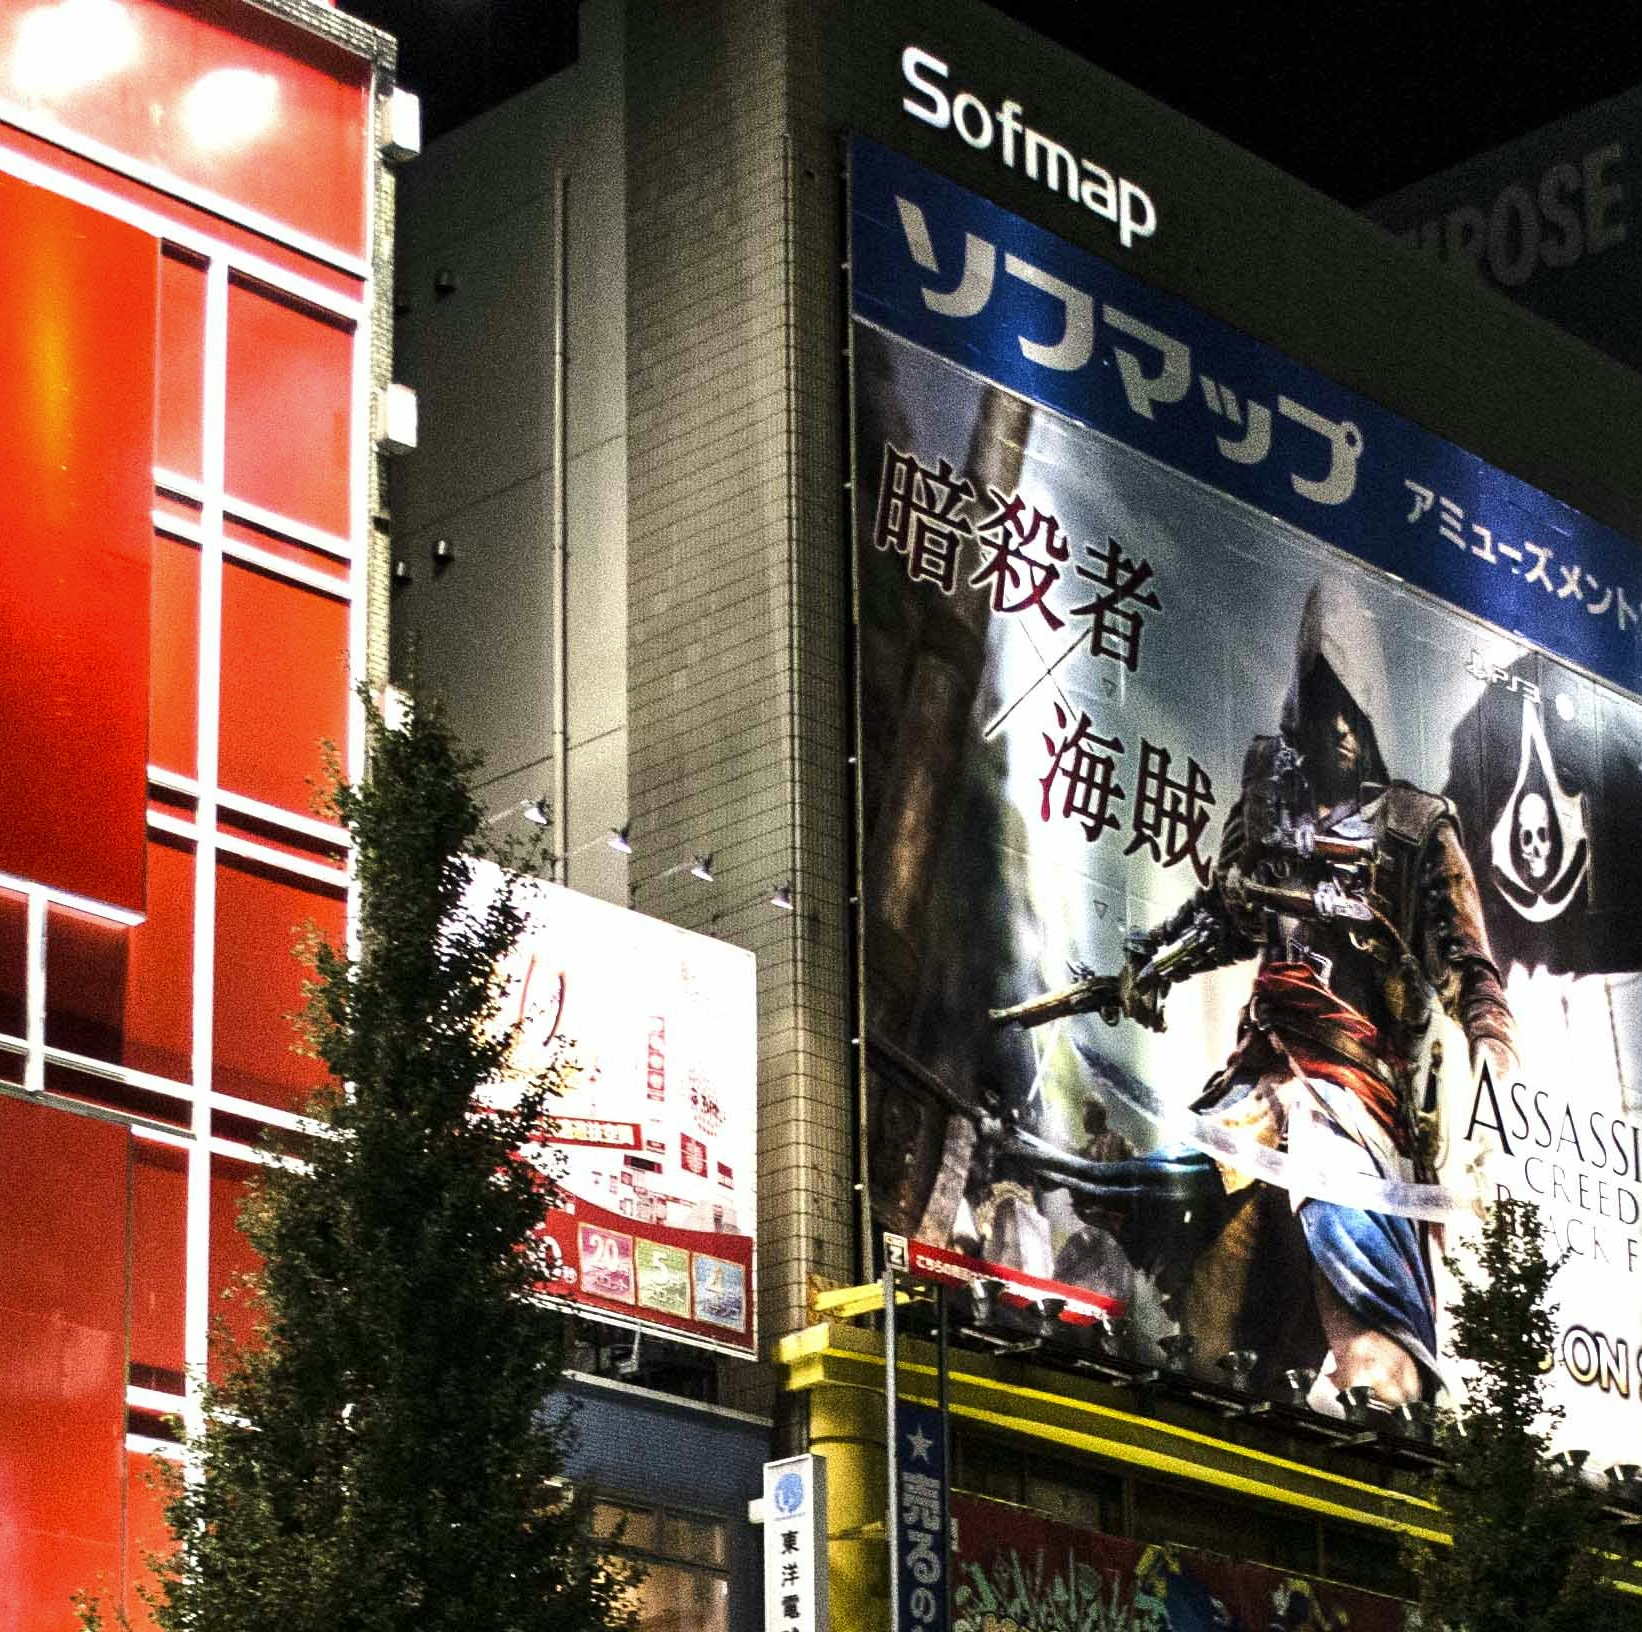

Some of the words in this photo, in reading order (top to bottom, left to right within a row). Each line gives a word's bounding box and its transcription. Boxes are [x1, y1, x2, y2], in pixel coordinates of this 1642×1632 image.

[901, 46, 1157, 248] Sofmap
[894, 193, 1364, 507] ソフマップ
[874, 441, 1163, 673] 暗殺者
[1039, 701, 1216, 889] 海賊
[1523, 1155, 1640, 1227] CREED
[1560, 1323, 1630, 1401] ON
